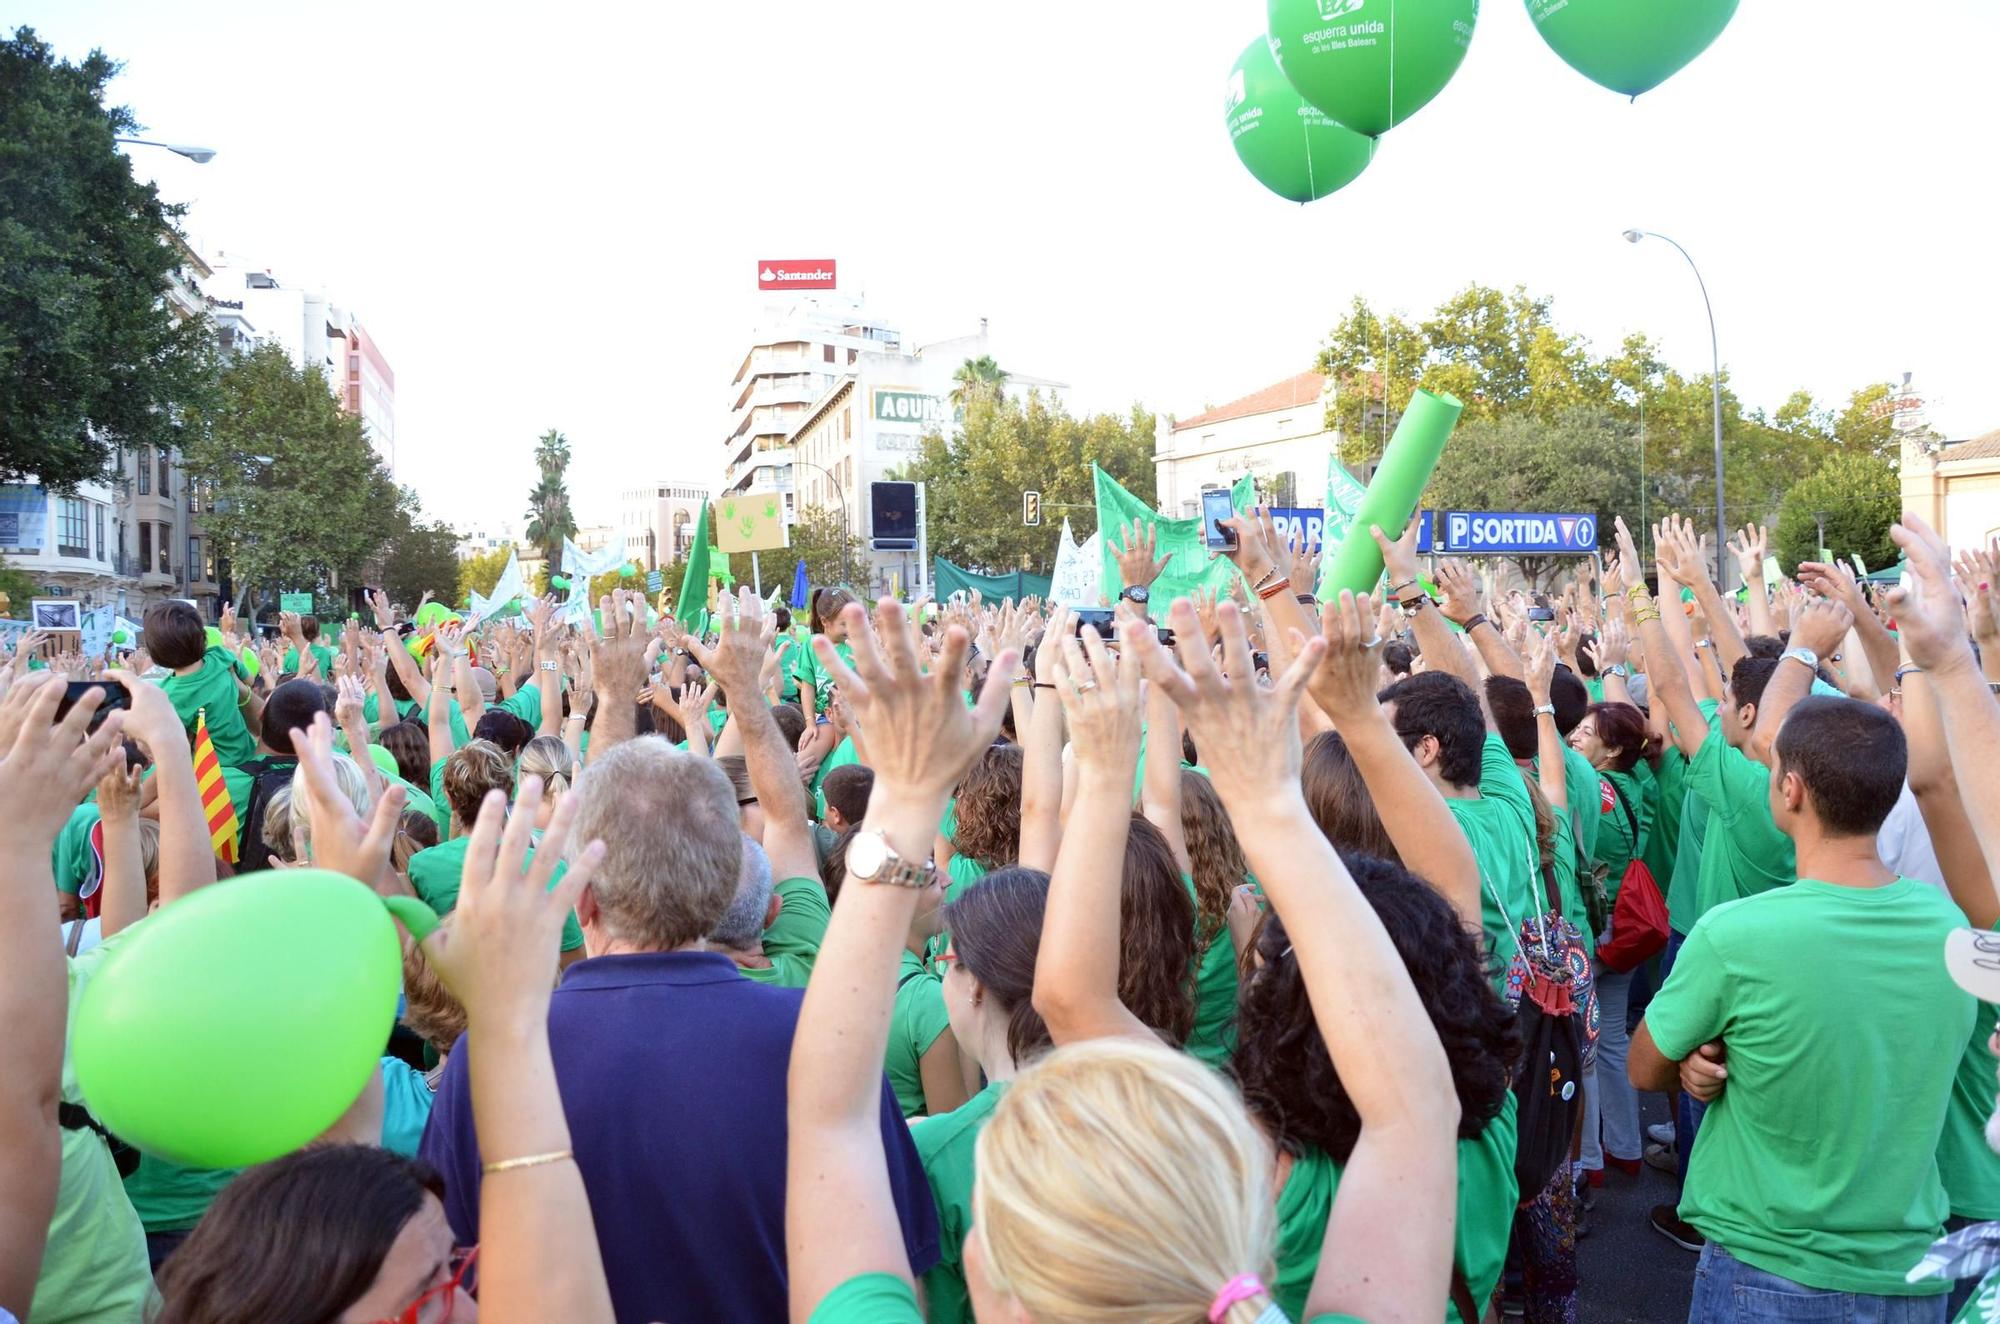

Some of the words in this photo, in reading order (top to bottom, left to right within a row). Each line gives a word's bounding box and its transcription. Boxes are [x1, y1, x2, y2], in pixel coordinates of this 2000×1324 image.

[1303, 25, 1347, 44] esquerra
[1349, 20, 1385, 35] unida
[1347, 37, 1377, 48] Balears
[777, 268, 833, 281] Santander
[1472, 518, 1559, 545] SORTIDA
